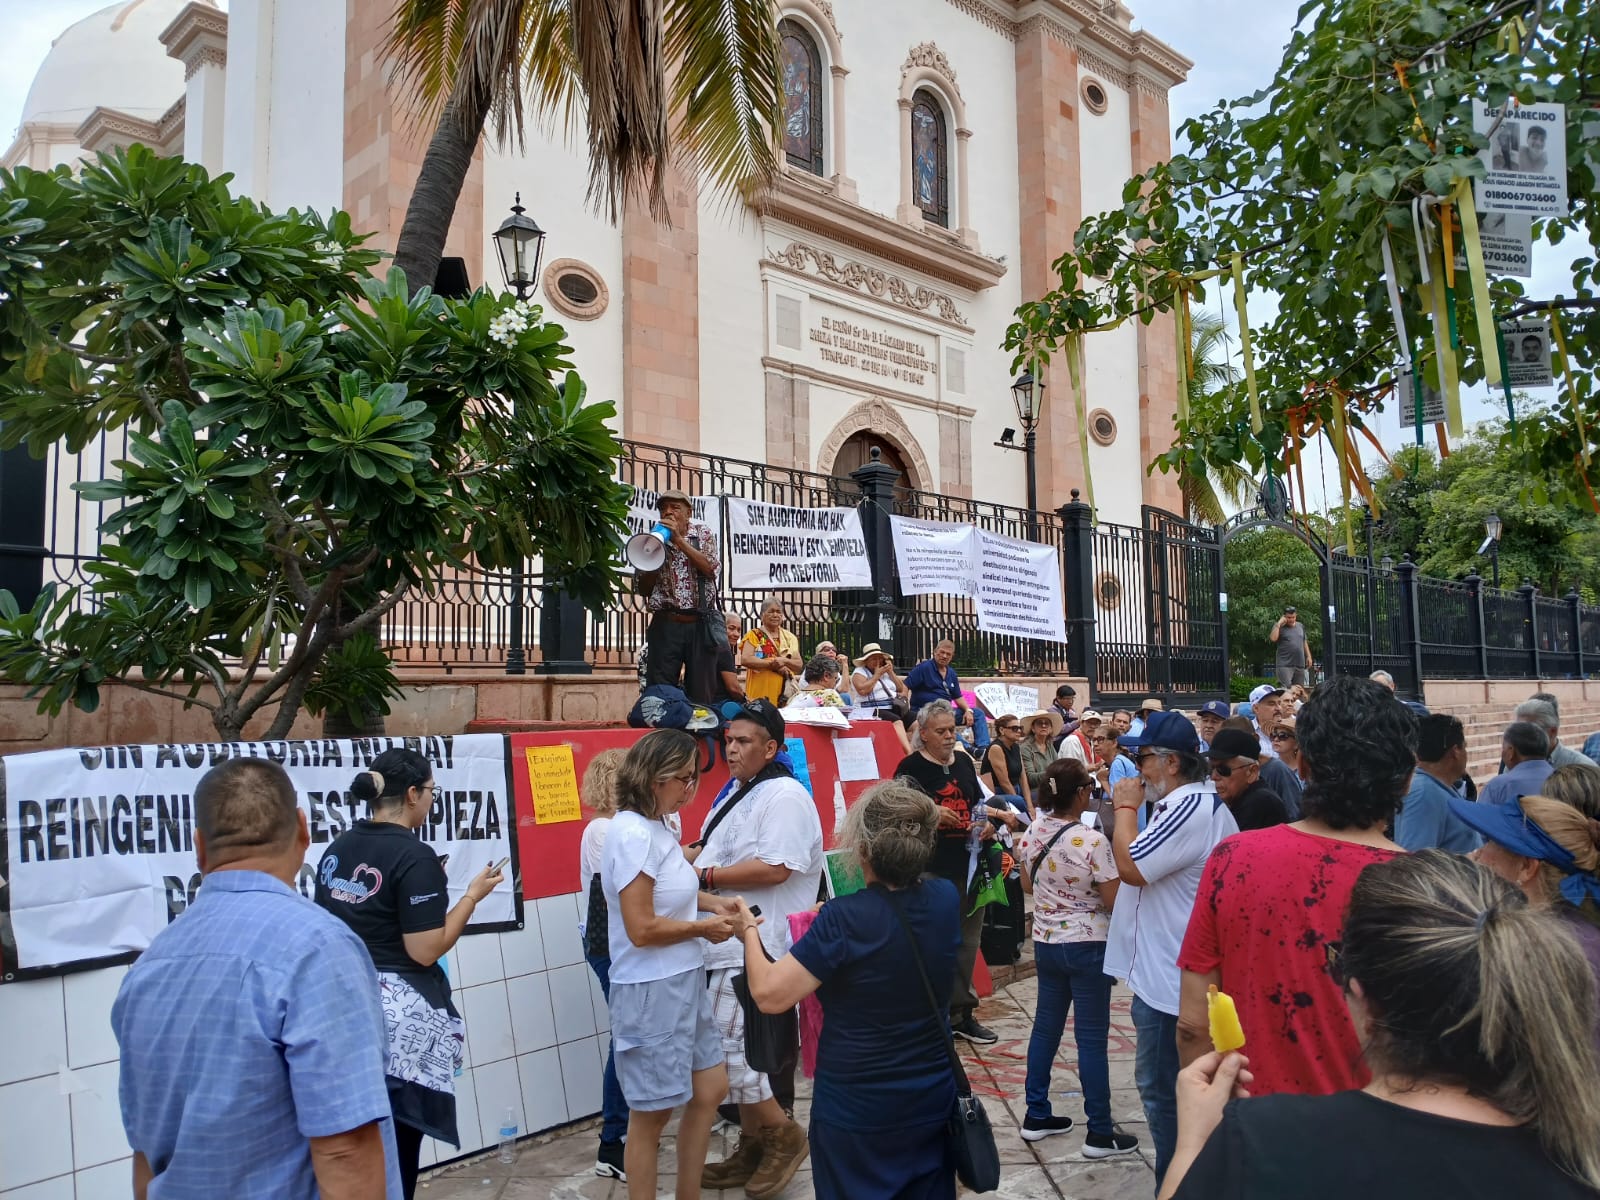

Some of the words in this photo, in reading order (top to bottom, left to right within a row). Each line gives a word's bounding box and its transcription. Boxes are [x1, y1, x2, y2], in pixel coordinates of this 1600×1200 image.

[1485, 190, 1556, 202] 018006703600
[1482, 250, 1527, 264] 6703600
[746, 504, 766, 526] SIN
[768, 506, 816, 530] AUDITORIA
[818, 510, 829, 532] NO
[830, 511, 846, 532] HAY
[733, 533, 798, 557] REINGENIERIA
[799, 538, 804, 557] Y
[806, 538, 829, 558] ESTA
[829, 538, 865, 557] EMPIEZA
[769, 562, 791, 584] POR
[791, 563, 841, 584] RECTORIA
[18, 794, 198, 864] REINGENI
